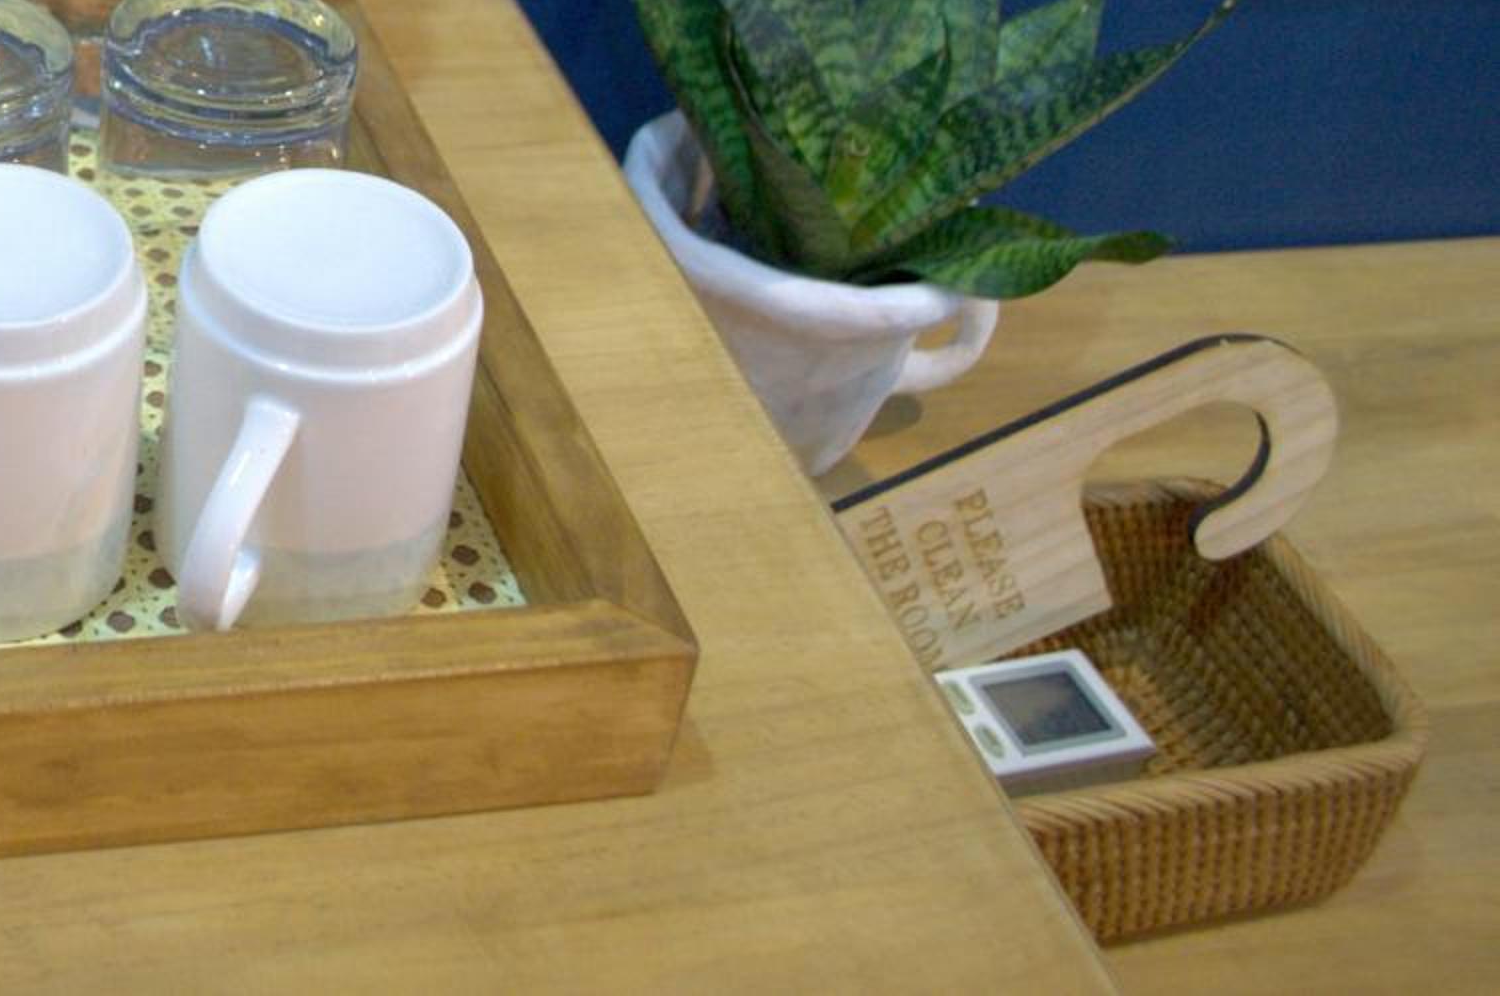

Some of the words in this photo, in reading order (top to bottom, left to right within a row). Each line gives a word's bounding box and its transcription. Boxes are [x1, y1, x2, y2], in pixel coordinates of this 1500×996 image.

[861, 505, 912, 581] THE
[916, 520, 982, 632] CLEAN
[955, 488, 1026, 619] PLEASE
